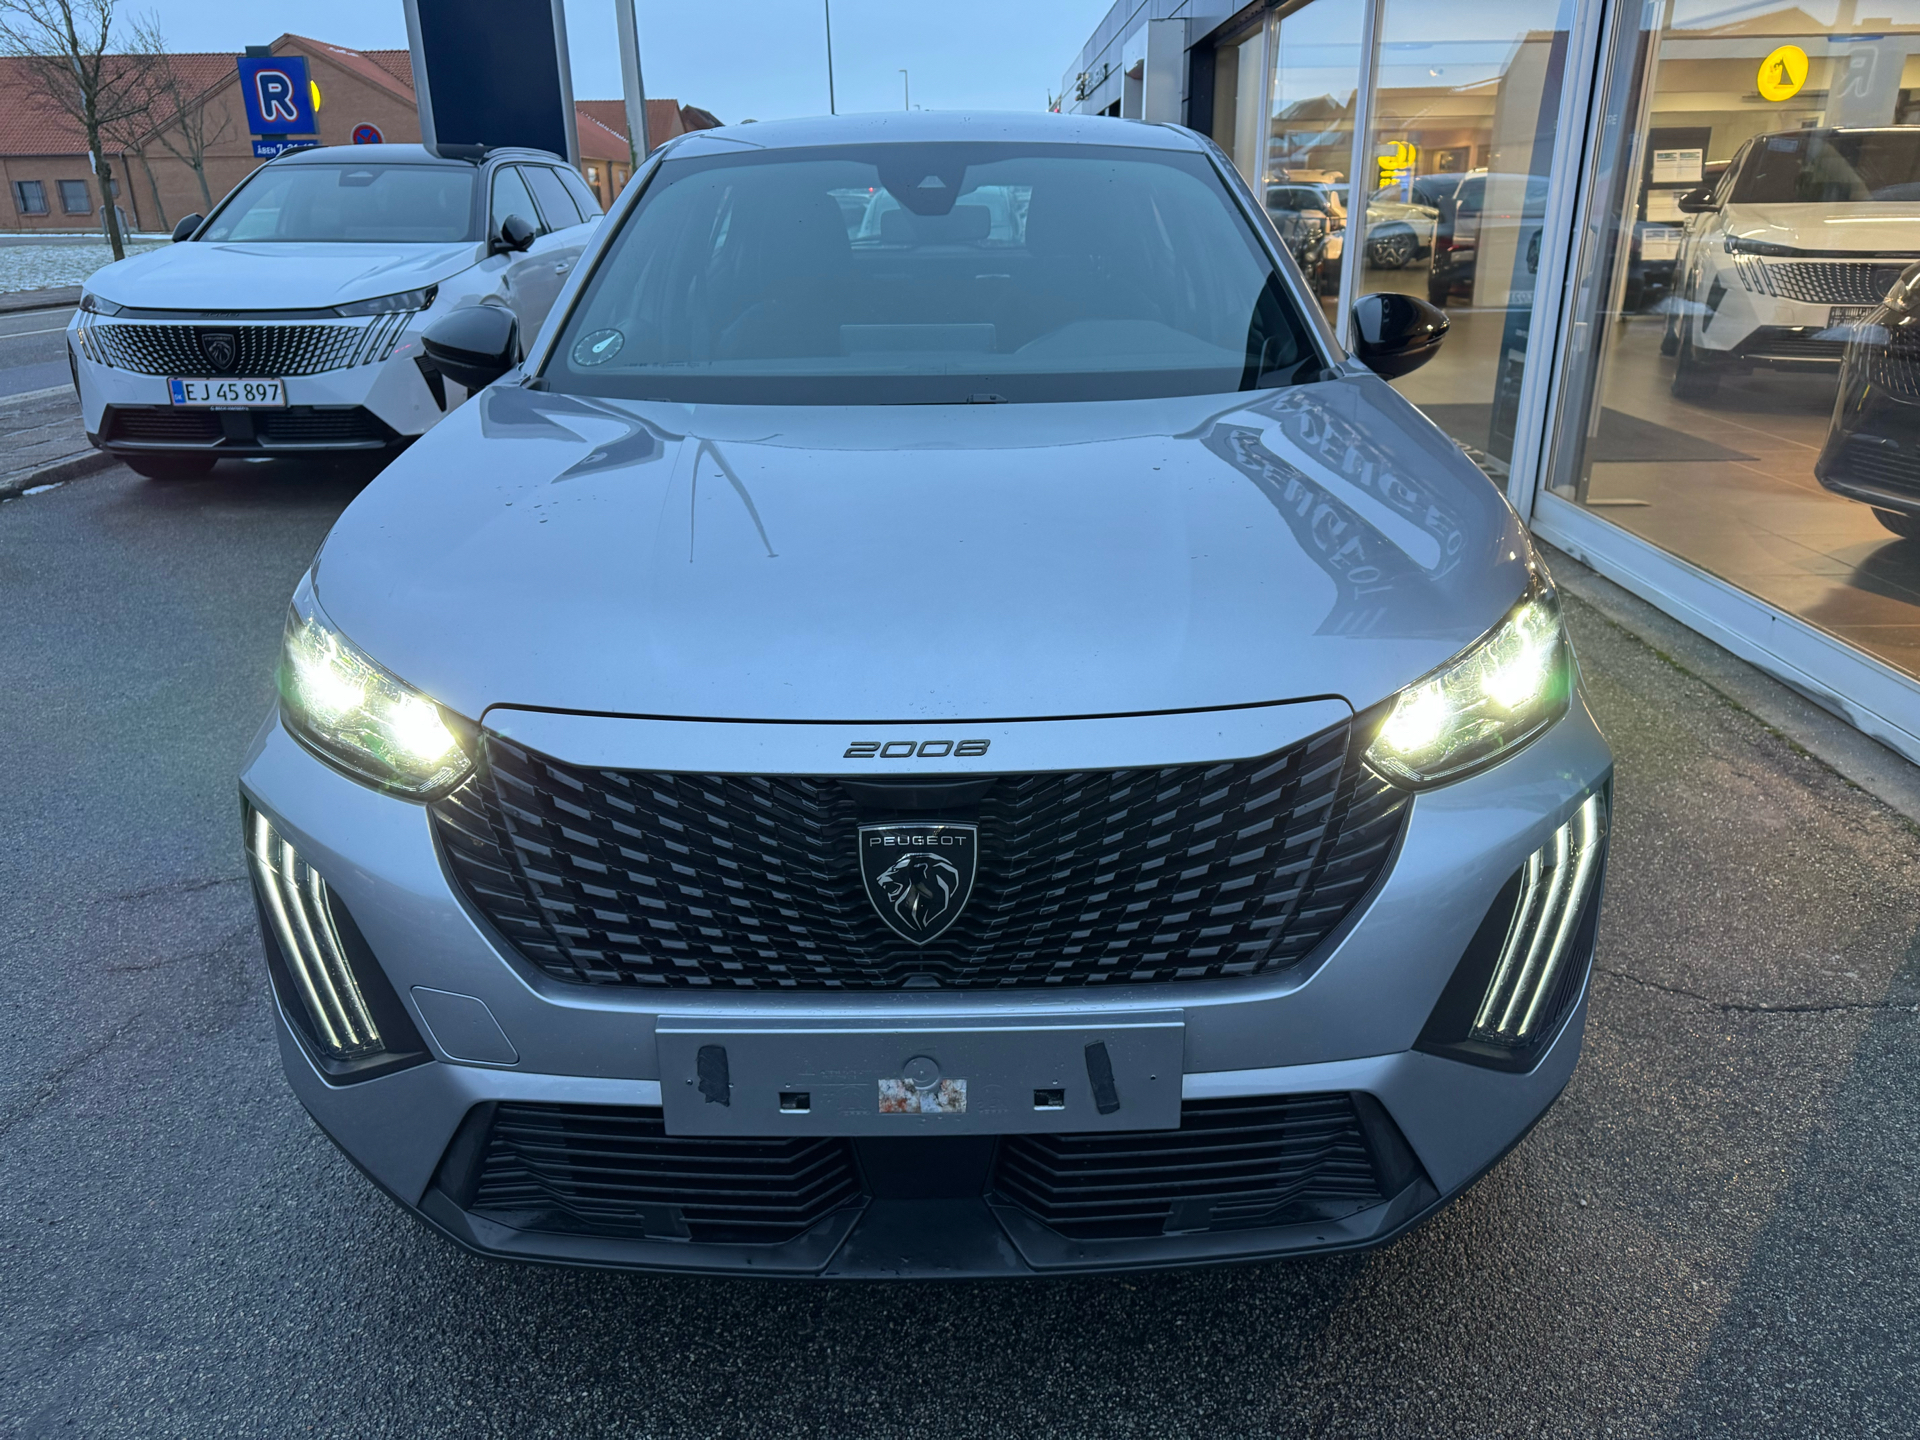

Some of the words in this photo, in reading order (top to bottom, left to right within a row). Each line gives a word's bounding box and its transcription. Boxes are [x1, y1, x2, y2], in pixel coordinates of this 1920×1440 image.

[255, 69, 299, 122] R
[257, 144, 277, 154] ÅBEN
[185, 383, 210, 401] EJ
[217, 383, 239, 401] 45
[243, 383, 279, 401] 897
[843, 739, 990, 758] 2008
[869, 835, 967, 847] PEUGEOT
